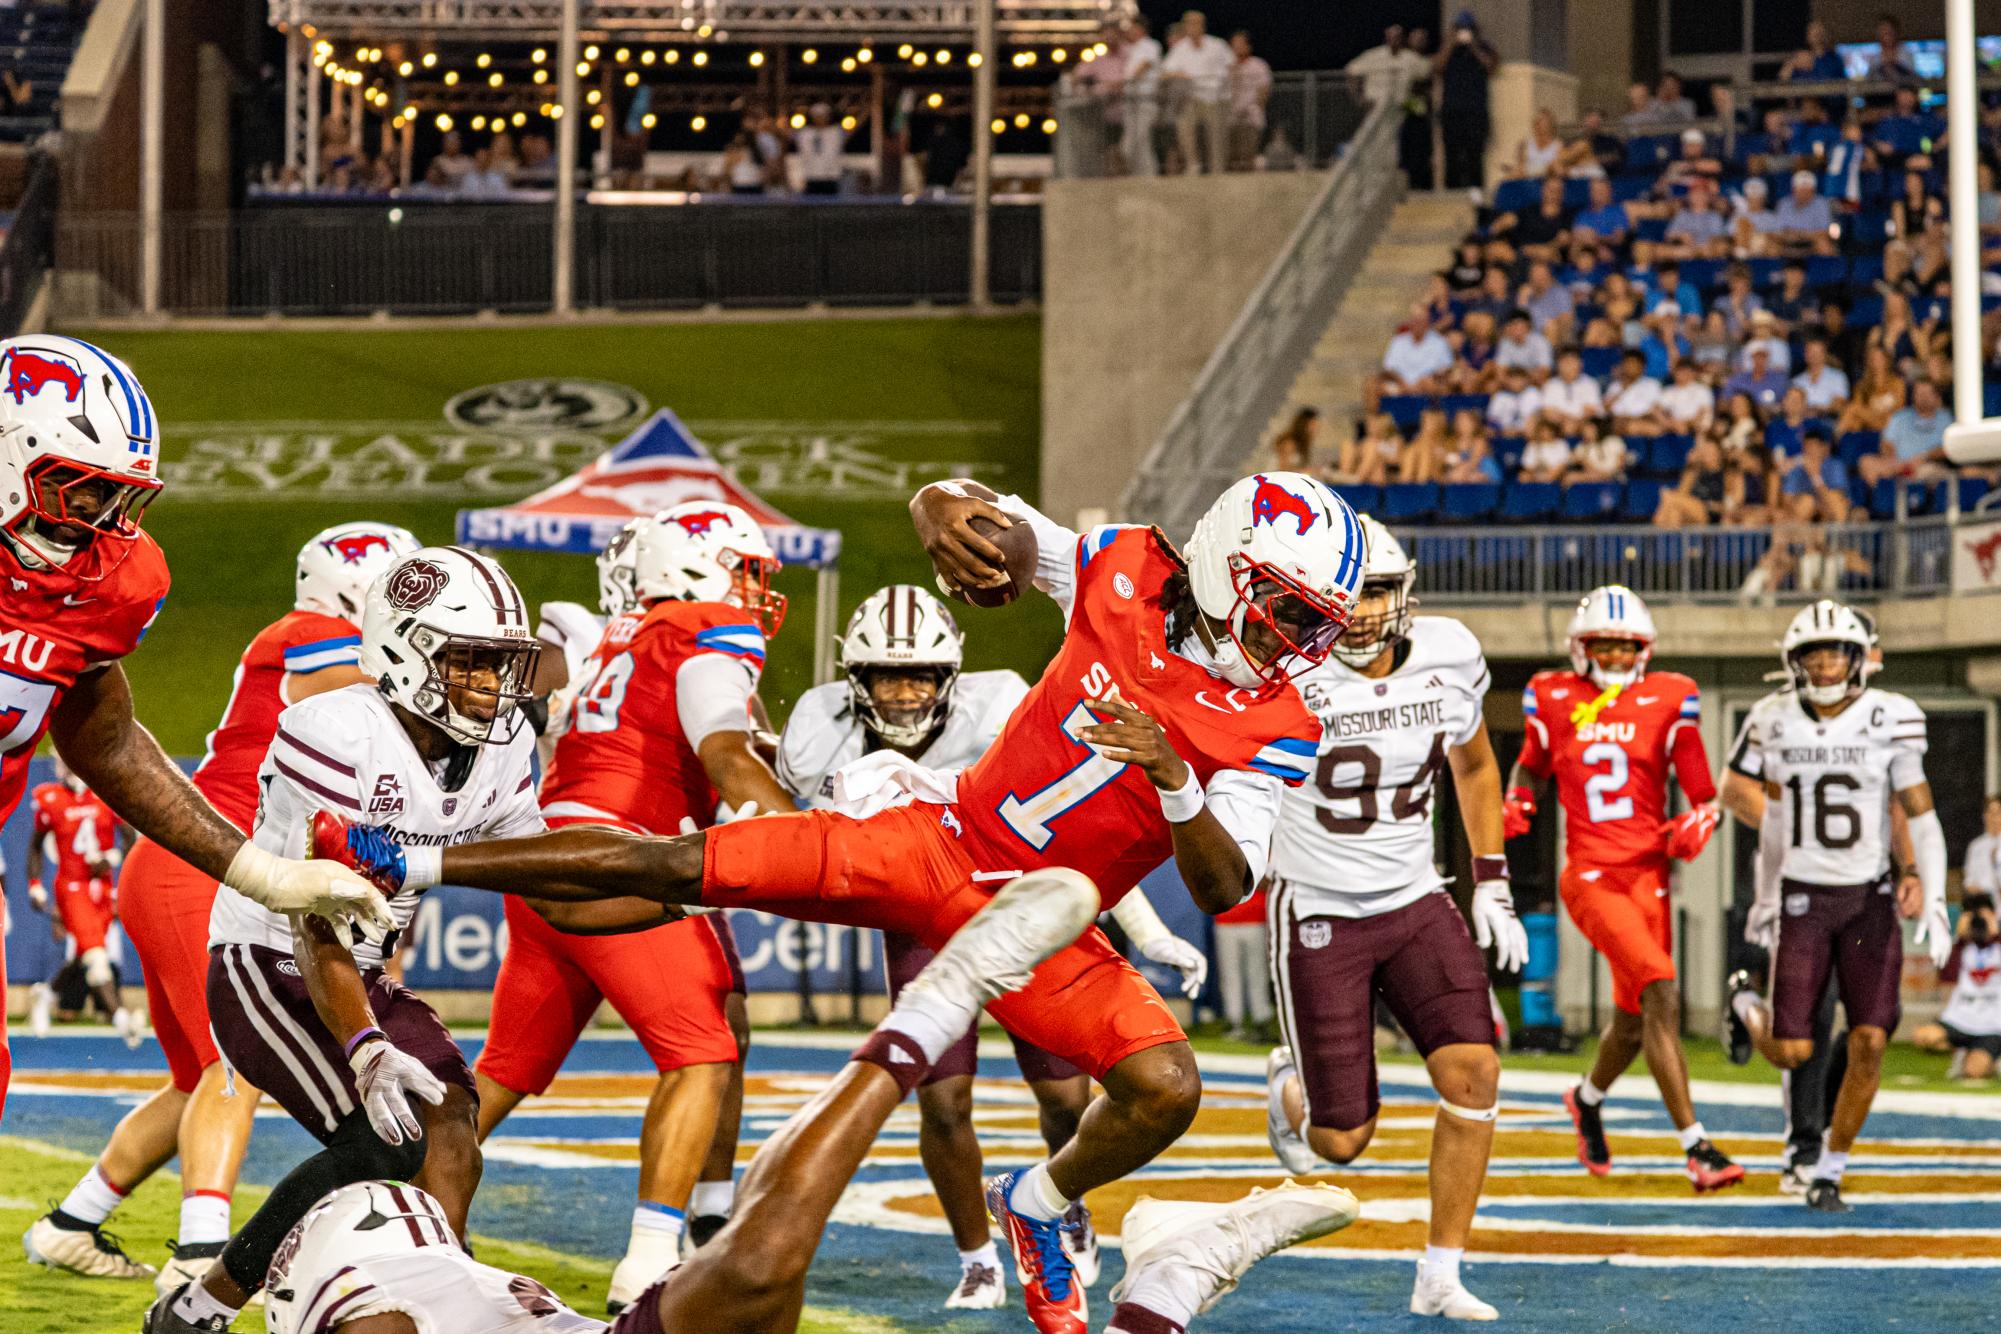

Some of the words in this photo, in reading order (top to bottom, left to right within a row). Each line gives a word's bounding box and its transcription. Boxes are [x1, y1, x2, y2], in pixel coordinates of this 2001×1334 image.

[466, 512, 570, 545] SMU
[503, 628, 527, 638] BEARS
[1324, 707, 1397, 739] MISSOURI
[1400, 698, 1444, 727] STATE
[1870, 706, 1884, 728] C
[994, 698, 1130, 855] 1
[1315, 730, 1447, 836] 94
[1582, 742, 1634, 823] 2
[368, 797, 404, 813] USA
[1785, 773, 1862, 850] 16
[72, 816, 102, 865] 4
